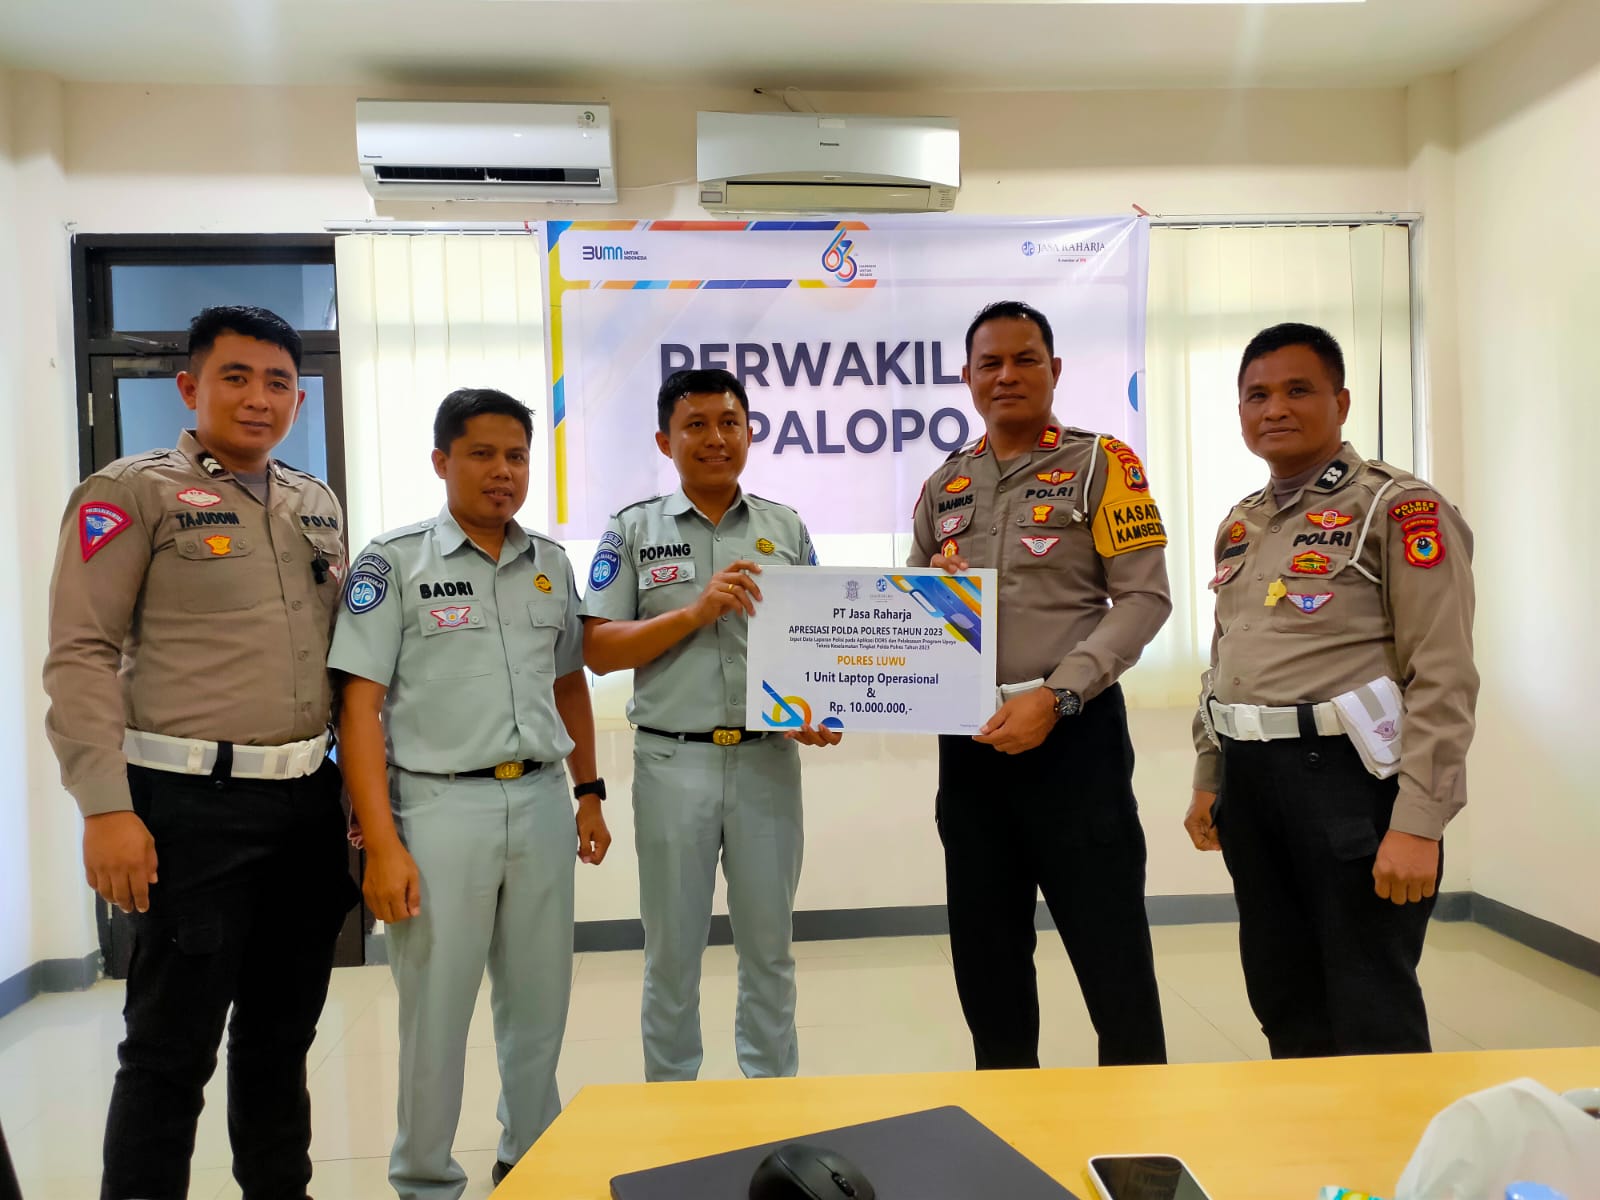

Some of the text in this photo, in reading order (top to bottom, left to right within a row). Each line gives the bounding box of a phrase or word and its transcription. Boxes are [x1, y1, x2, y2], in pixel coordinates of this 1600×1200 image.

[660, 341, 966, 387] PERWAKIL
[1025, 487, 1073, 498] POLRI
[1395, 501, 1435, 514] POLRES
[1402, 506, 1429, 515] LUWU
[1113, 504, 1162, 526] KASAT
[1293, 531, 1352, 547] POLRI
[640, 543, 691, 562] POPANG
[420, 581, 474, 599] BADRI
[833, 608, 912, 622] PT Jasa Raharja
[789, 626, 830, 634] APRESIASI
[861, 627, 890, 635] POLRES
[892, 627, 921, 635] TAHUN
[837, 656, 906, 666] POLRES LUWU
[805, 672, 939, 686] 1 Unit Laptop Operasional
[866, 687, 876, 698] &
[829, 701, 912, 715] Rp. 10.000.000,-
